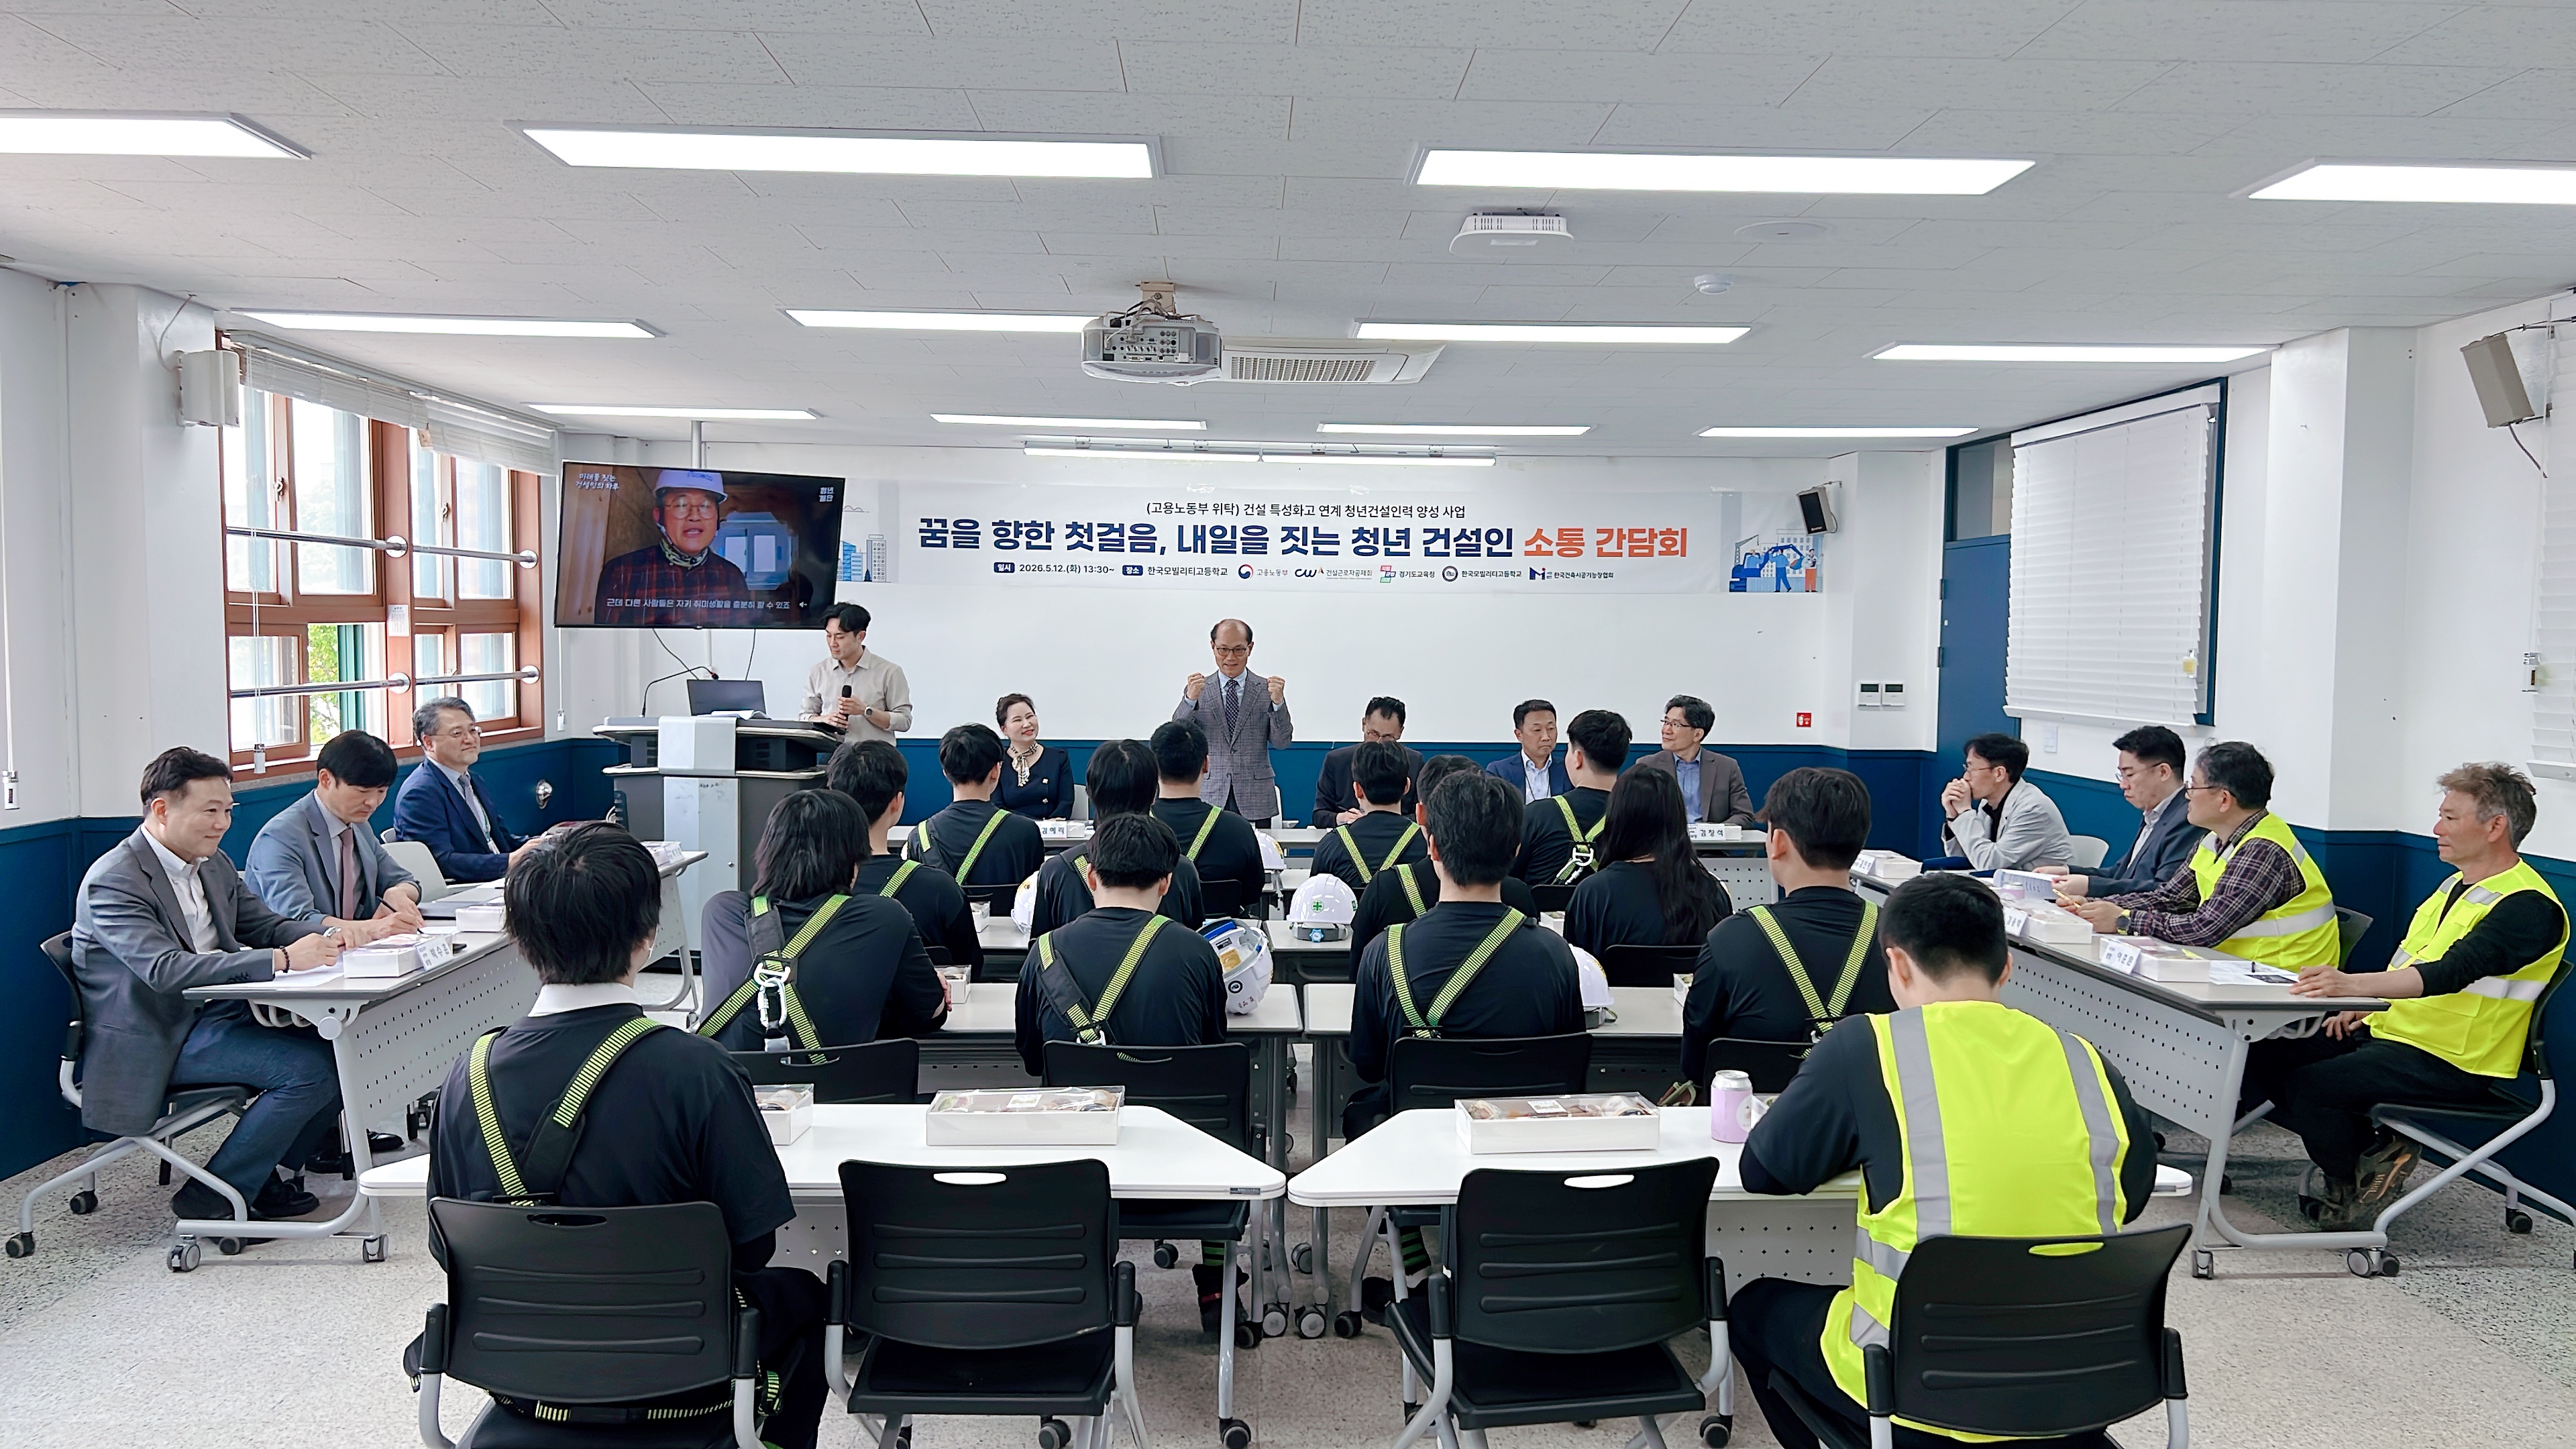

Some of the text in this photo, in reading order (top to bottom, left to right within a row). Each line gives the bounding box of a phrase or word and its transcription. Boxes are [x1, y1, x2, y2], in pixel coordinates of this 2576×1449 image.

[1146, 502, 1465, 519] (고용노동부 위탁) 건설 특성화고 연계 청년건설인력 양성 사업
[918, 518, 1688, 558] 꿈을 향한 첫걸음, 내일을 짓는 청년 건설인 소통 간담회
[997, 564, 1228, 576] 일시 2026.5.12.(화) 13:30~ 장소 한국모빌리티고등학교
[1399, 570, 1435, 578] 경기도교육청
[766, 601, 773, 609] 수
